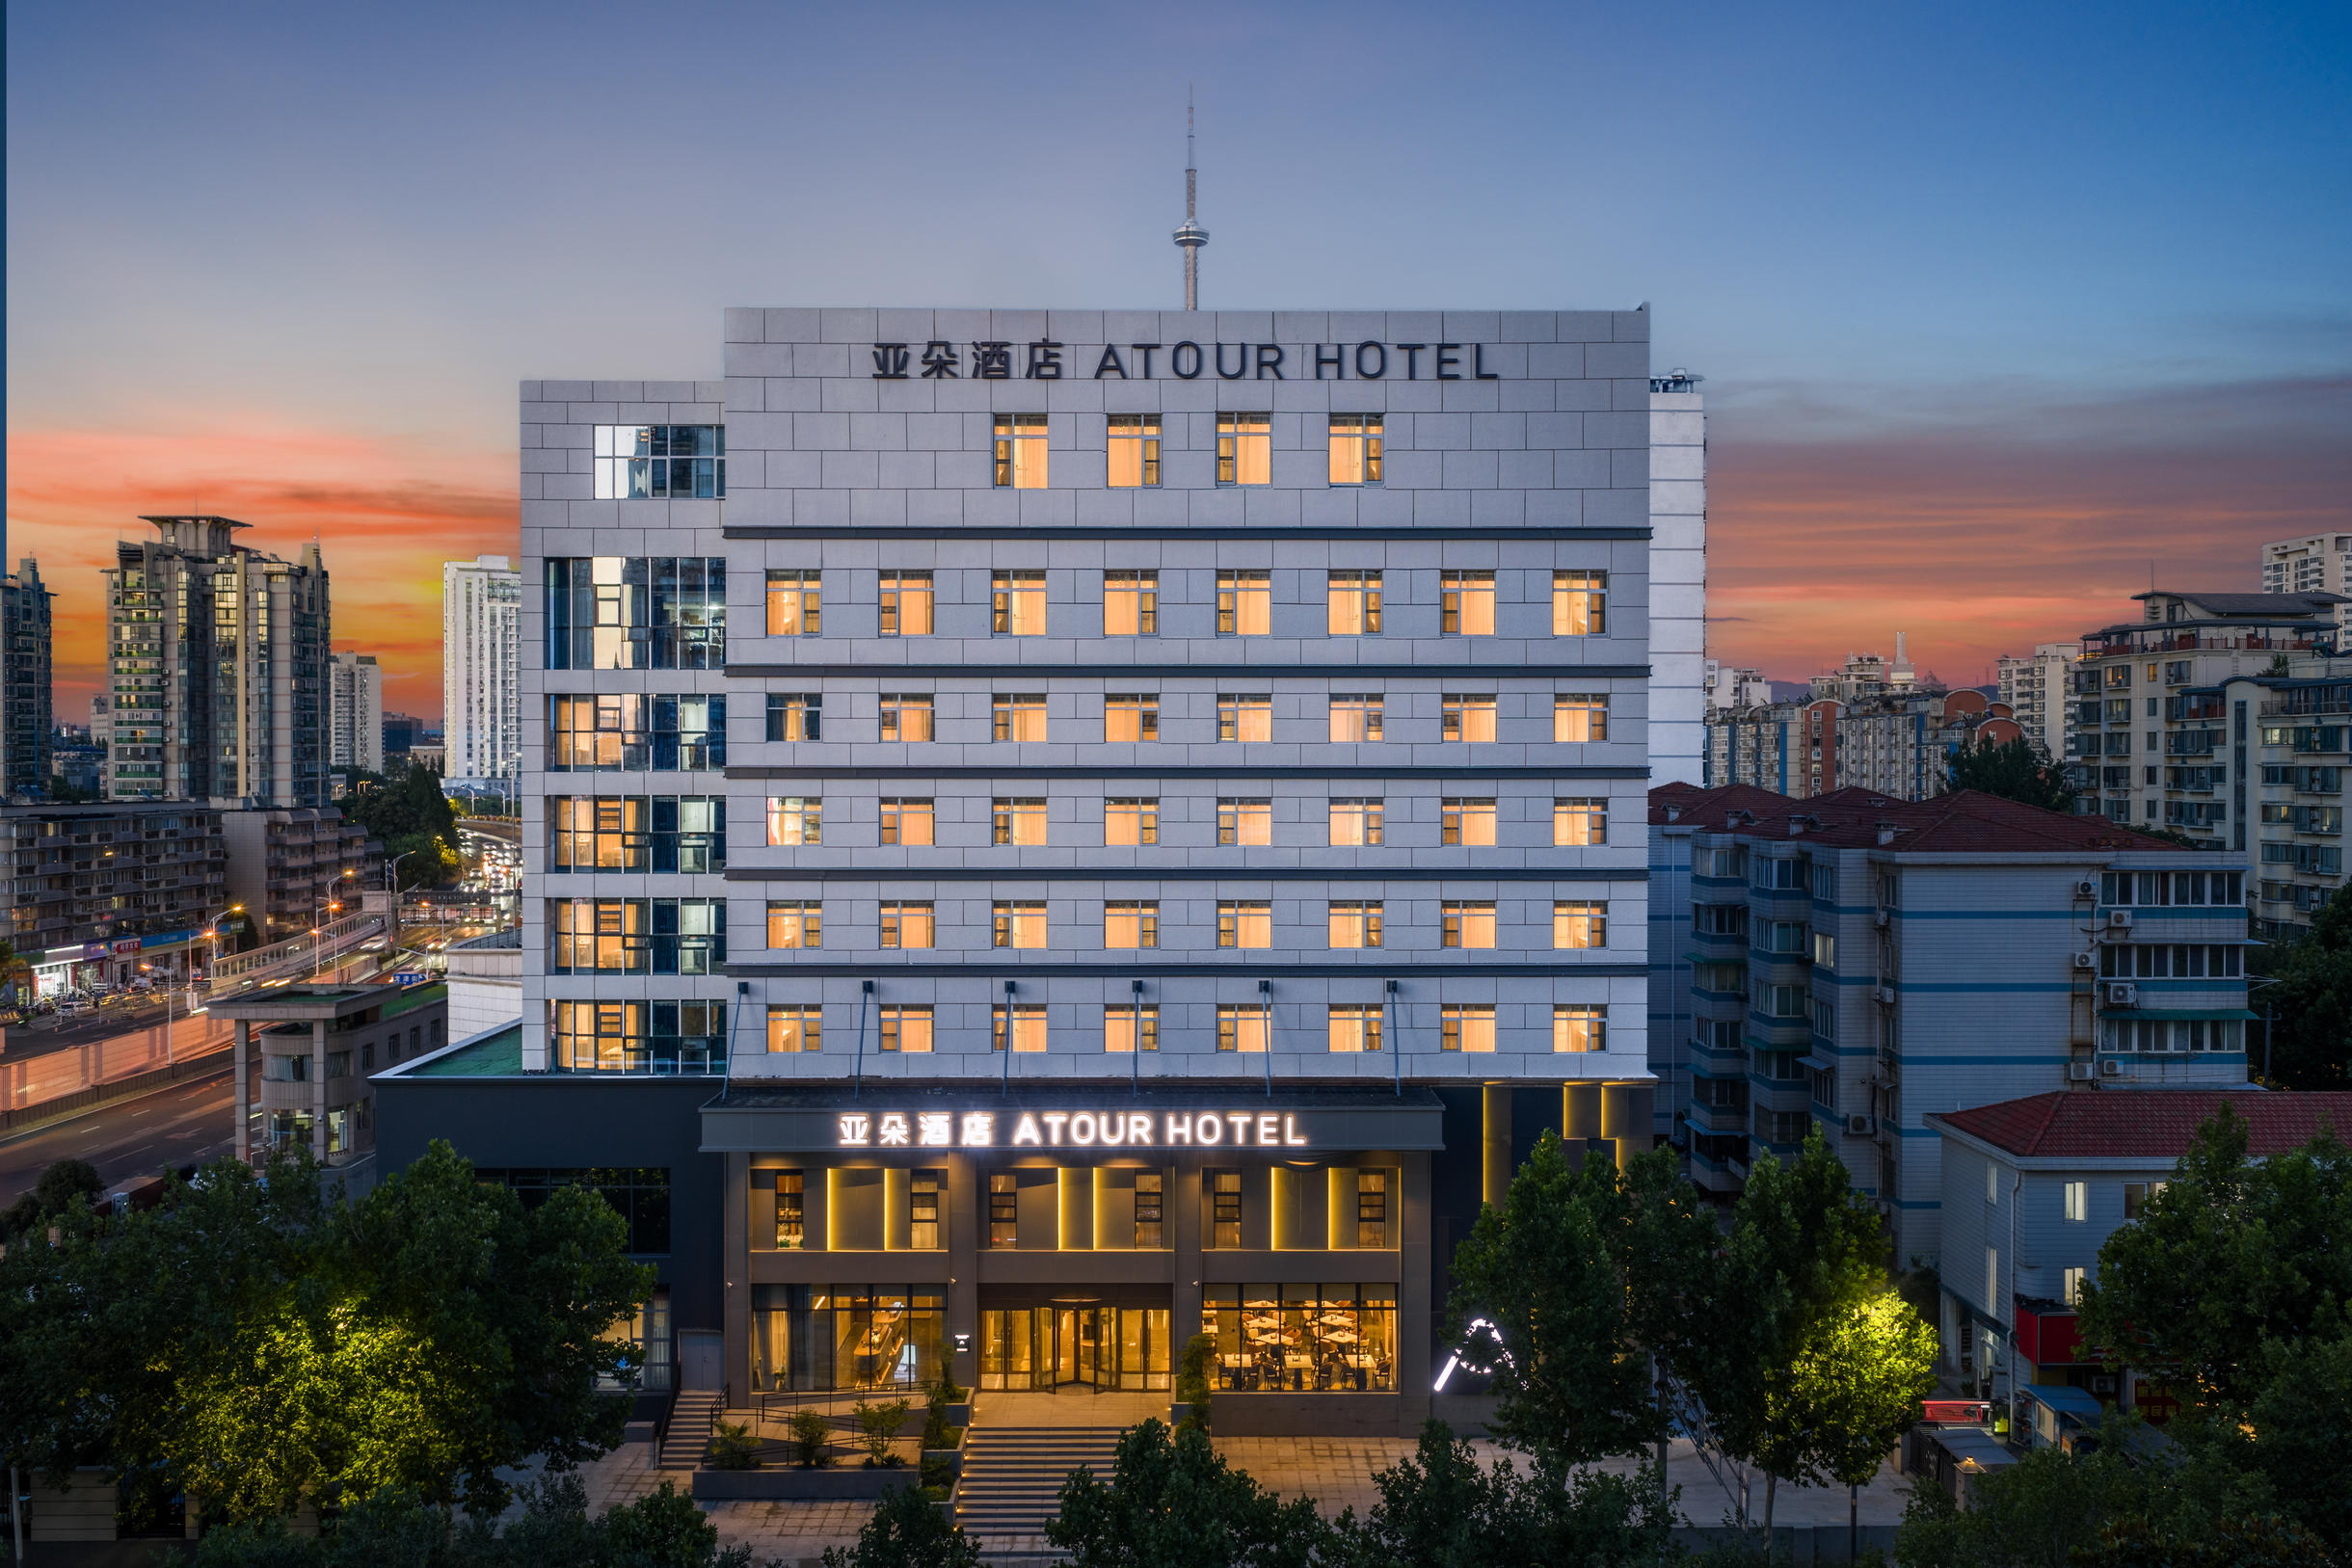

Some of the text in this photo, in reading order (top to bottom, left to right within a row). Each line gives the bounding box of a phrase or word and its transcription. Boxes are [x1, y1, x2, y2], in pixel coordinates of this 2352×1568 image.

[872, 338, 1498, 381] 亚朵酒店 ATOUR HOTEL
[840, 1112, 1305, 1147] 亚朵酒店 ATOUR HOTEL
